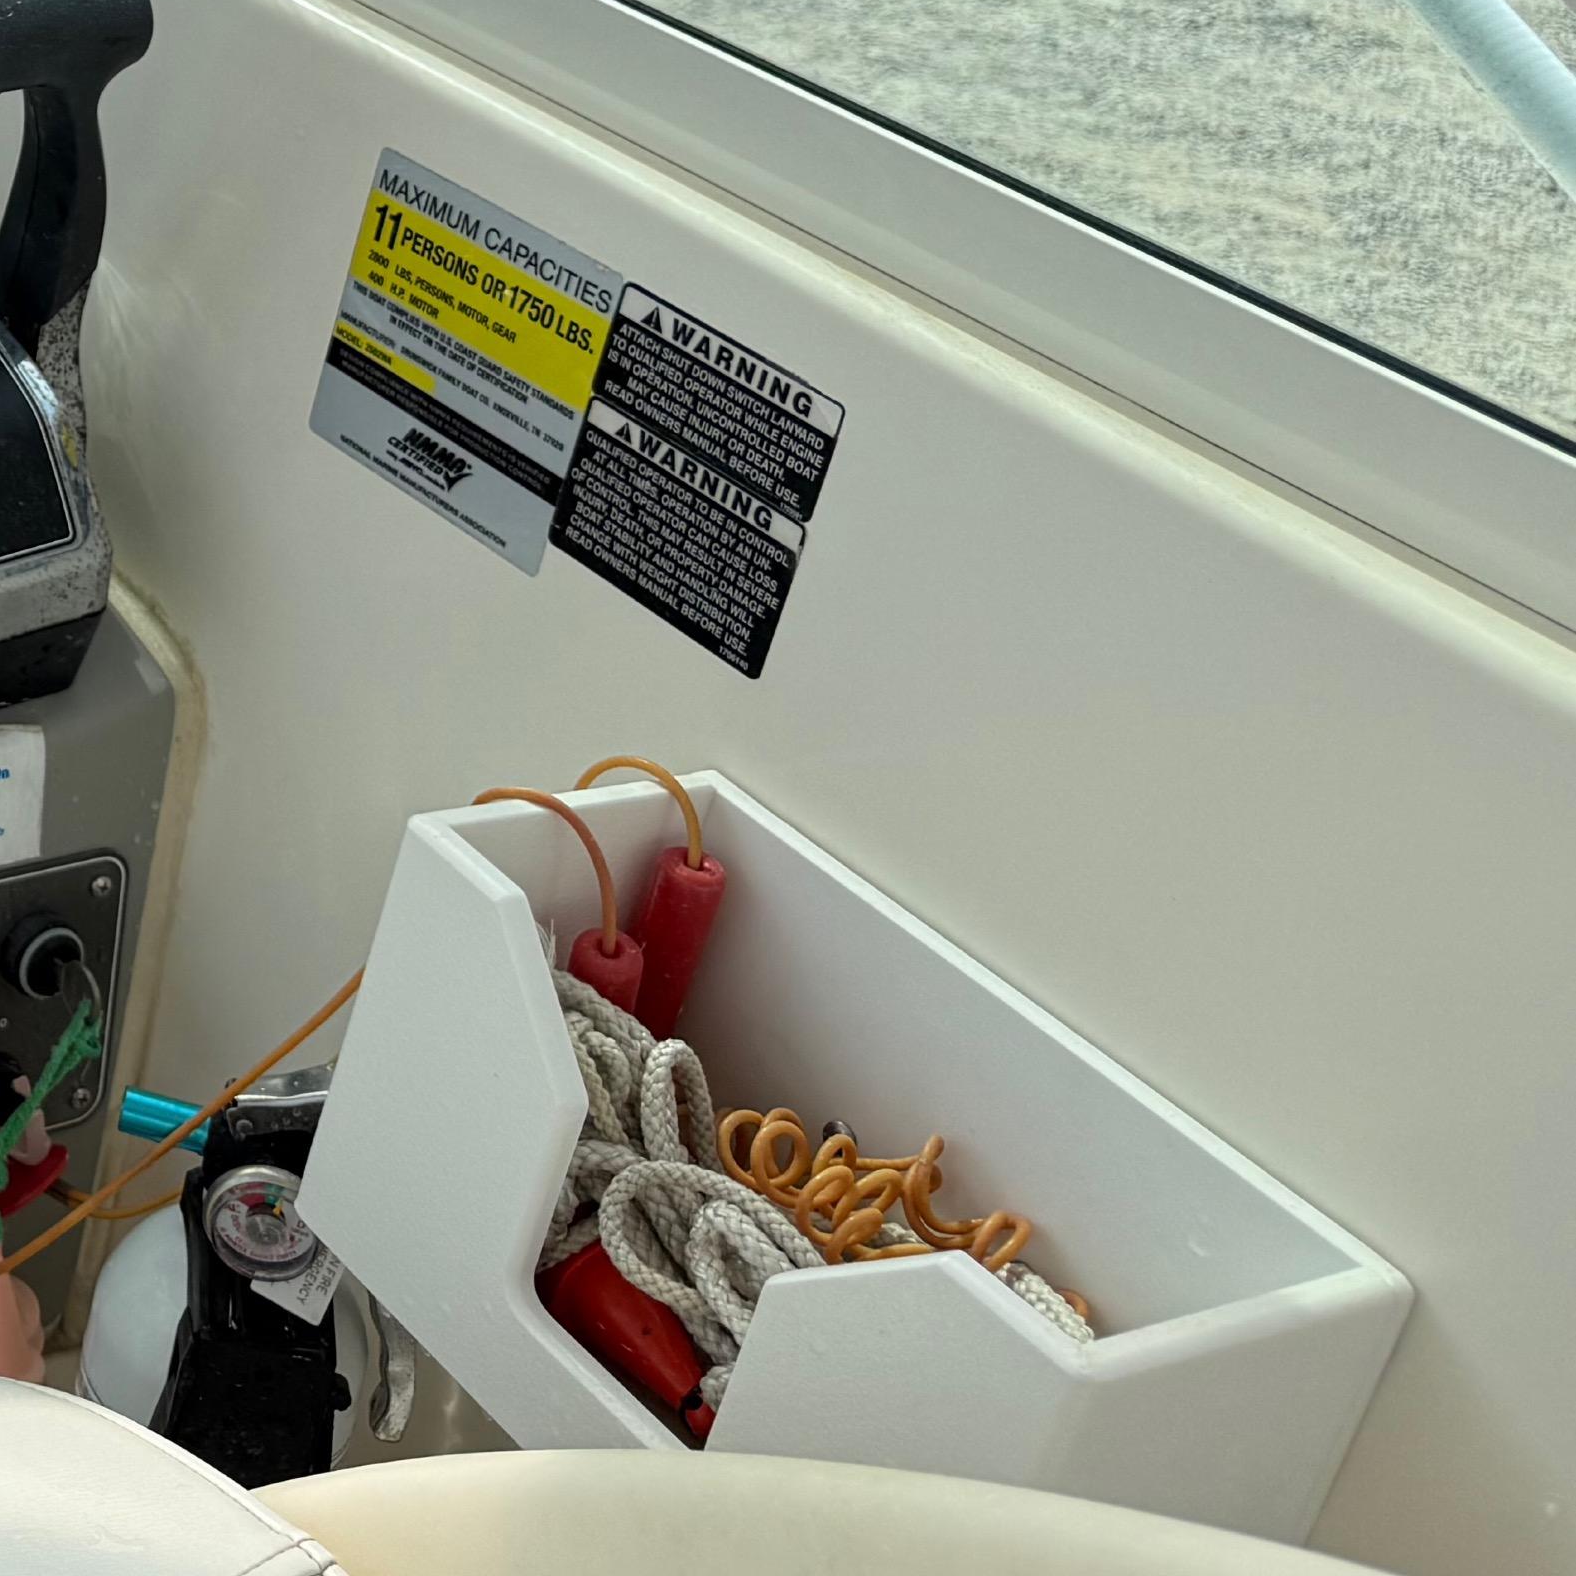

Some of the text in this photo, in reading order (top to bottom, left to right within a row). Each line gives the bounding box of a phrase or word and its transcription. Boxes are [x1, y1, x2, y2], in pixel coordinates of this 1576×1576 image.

[366, 269, 439, 320] 400 MOTOR
[368, 199, 599, 355] 11 PERSONS OR 1750 LBS.
[377, 167, 614, 315] MAXIMUM CAPACITIES
[412, 274, 457, 310] PERSONS,
[456, 299, 492, 330] MOTOR,
[490, 319, 517, 345] GEAR
[606, 347, 819, 483] IS IN UNCONTROLLED BOAT
[610, 333, 824, 469] TO QUALIFIED OPERATOR WHILE ENGINE
[618, 321, 825, 452] ATTACH SHUT DOWN SWITCH LANYARD
[625, 375, 745, 456] MAY CAUSE INJURY OR
[667, 316, 815, 419] WARNING
[386, 433, 444, 478] CERTIFIED
[603, 378, 775, 491] READ OWNERS MANUAL BEFORE
[635, 430, 776, 532] WARNING
[569, 465, 683, 547] OF THIS MAY
[579, 456, 778, 593] QUALIFIED OPERATOR CAN CAUSE LOSS
[584, 428, 791, 568] QUALIFIED OPERATOR TO BE IN CONTROL
[592, 448, 753, 560] AT ALL OPERATION BY AN
[316, 1267, 336, 1295] FIRE
